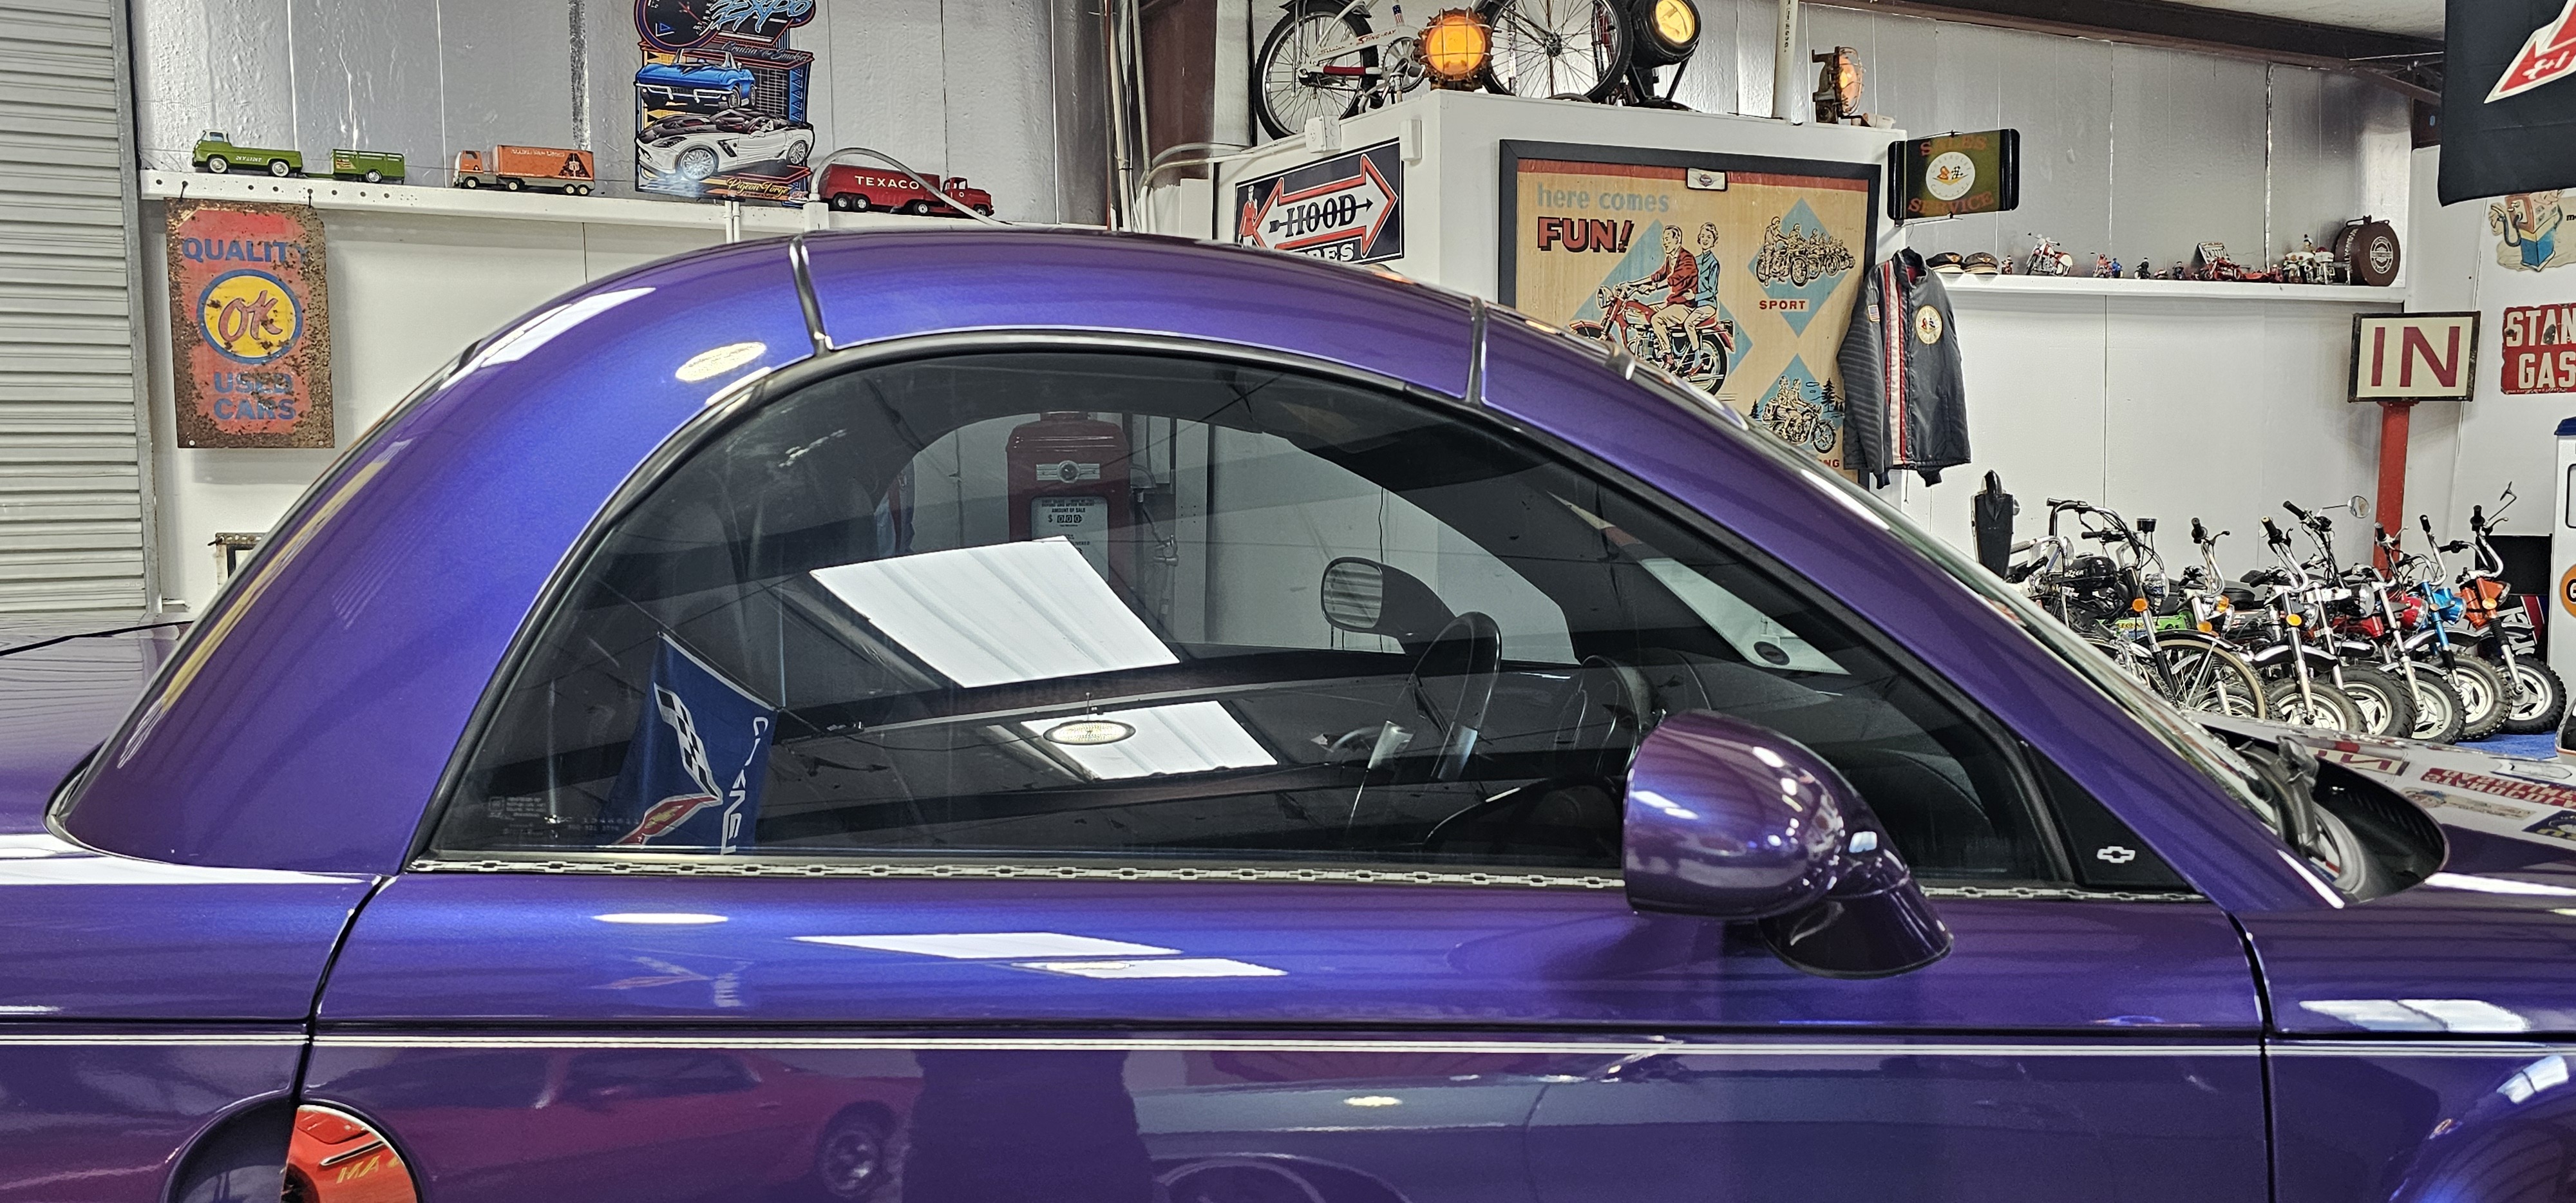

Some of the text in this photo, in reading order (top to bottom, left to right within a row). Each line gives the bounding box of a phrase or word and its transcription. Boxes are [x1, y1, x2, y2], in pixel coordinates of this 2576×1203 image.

[1920, 135, 1987, 156] SALES
[855, 175, 920, 190] TEXACO
[1537, 182, 1669, 213] here comes
[1285, 194, 1356, 238] HOOD
[1908, 191, 1994, 214] SERVICE
[1538, 216, 1634, 253] FUN!
[218, 290, 283, 342] OK
[1759, 300, 1805, 310] SPORT
[2371, 326, 2460, 387] IN
[2518, 351, 2576, 389] GAS
[213, 398, 296, 421] CARS
